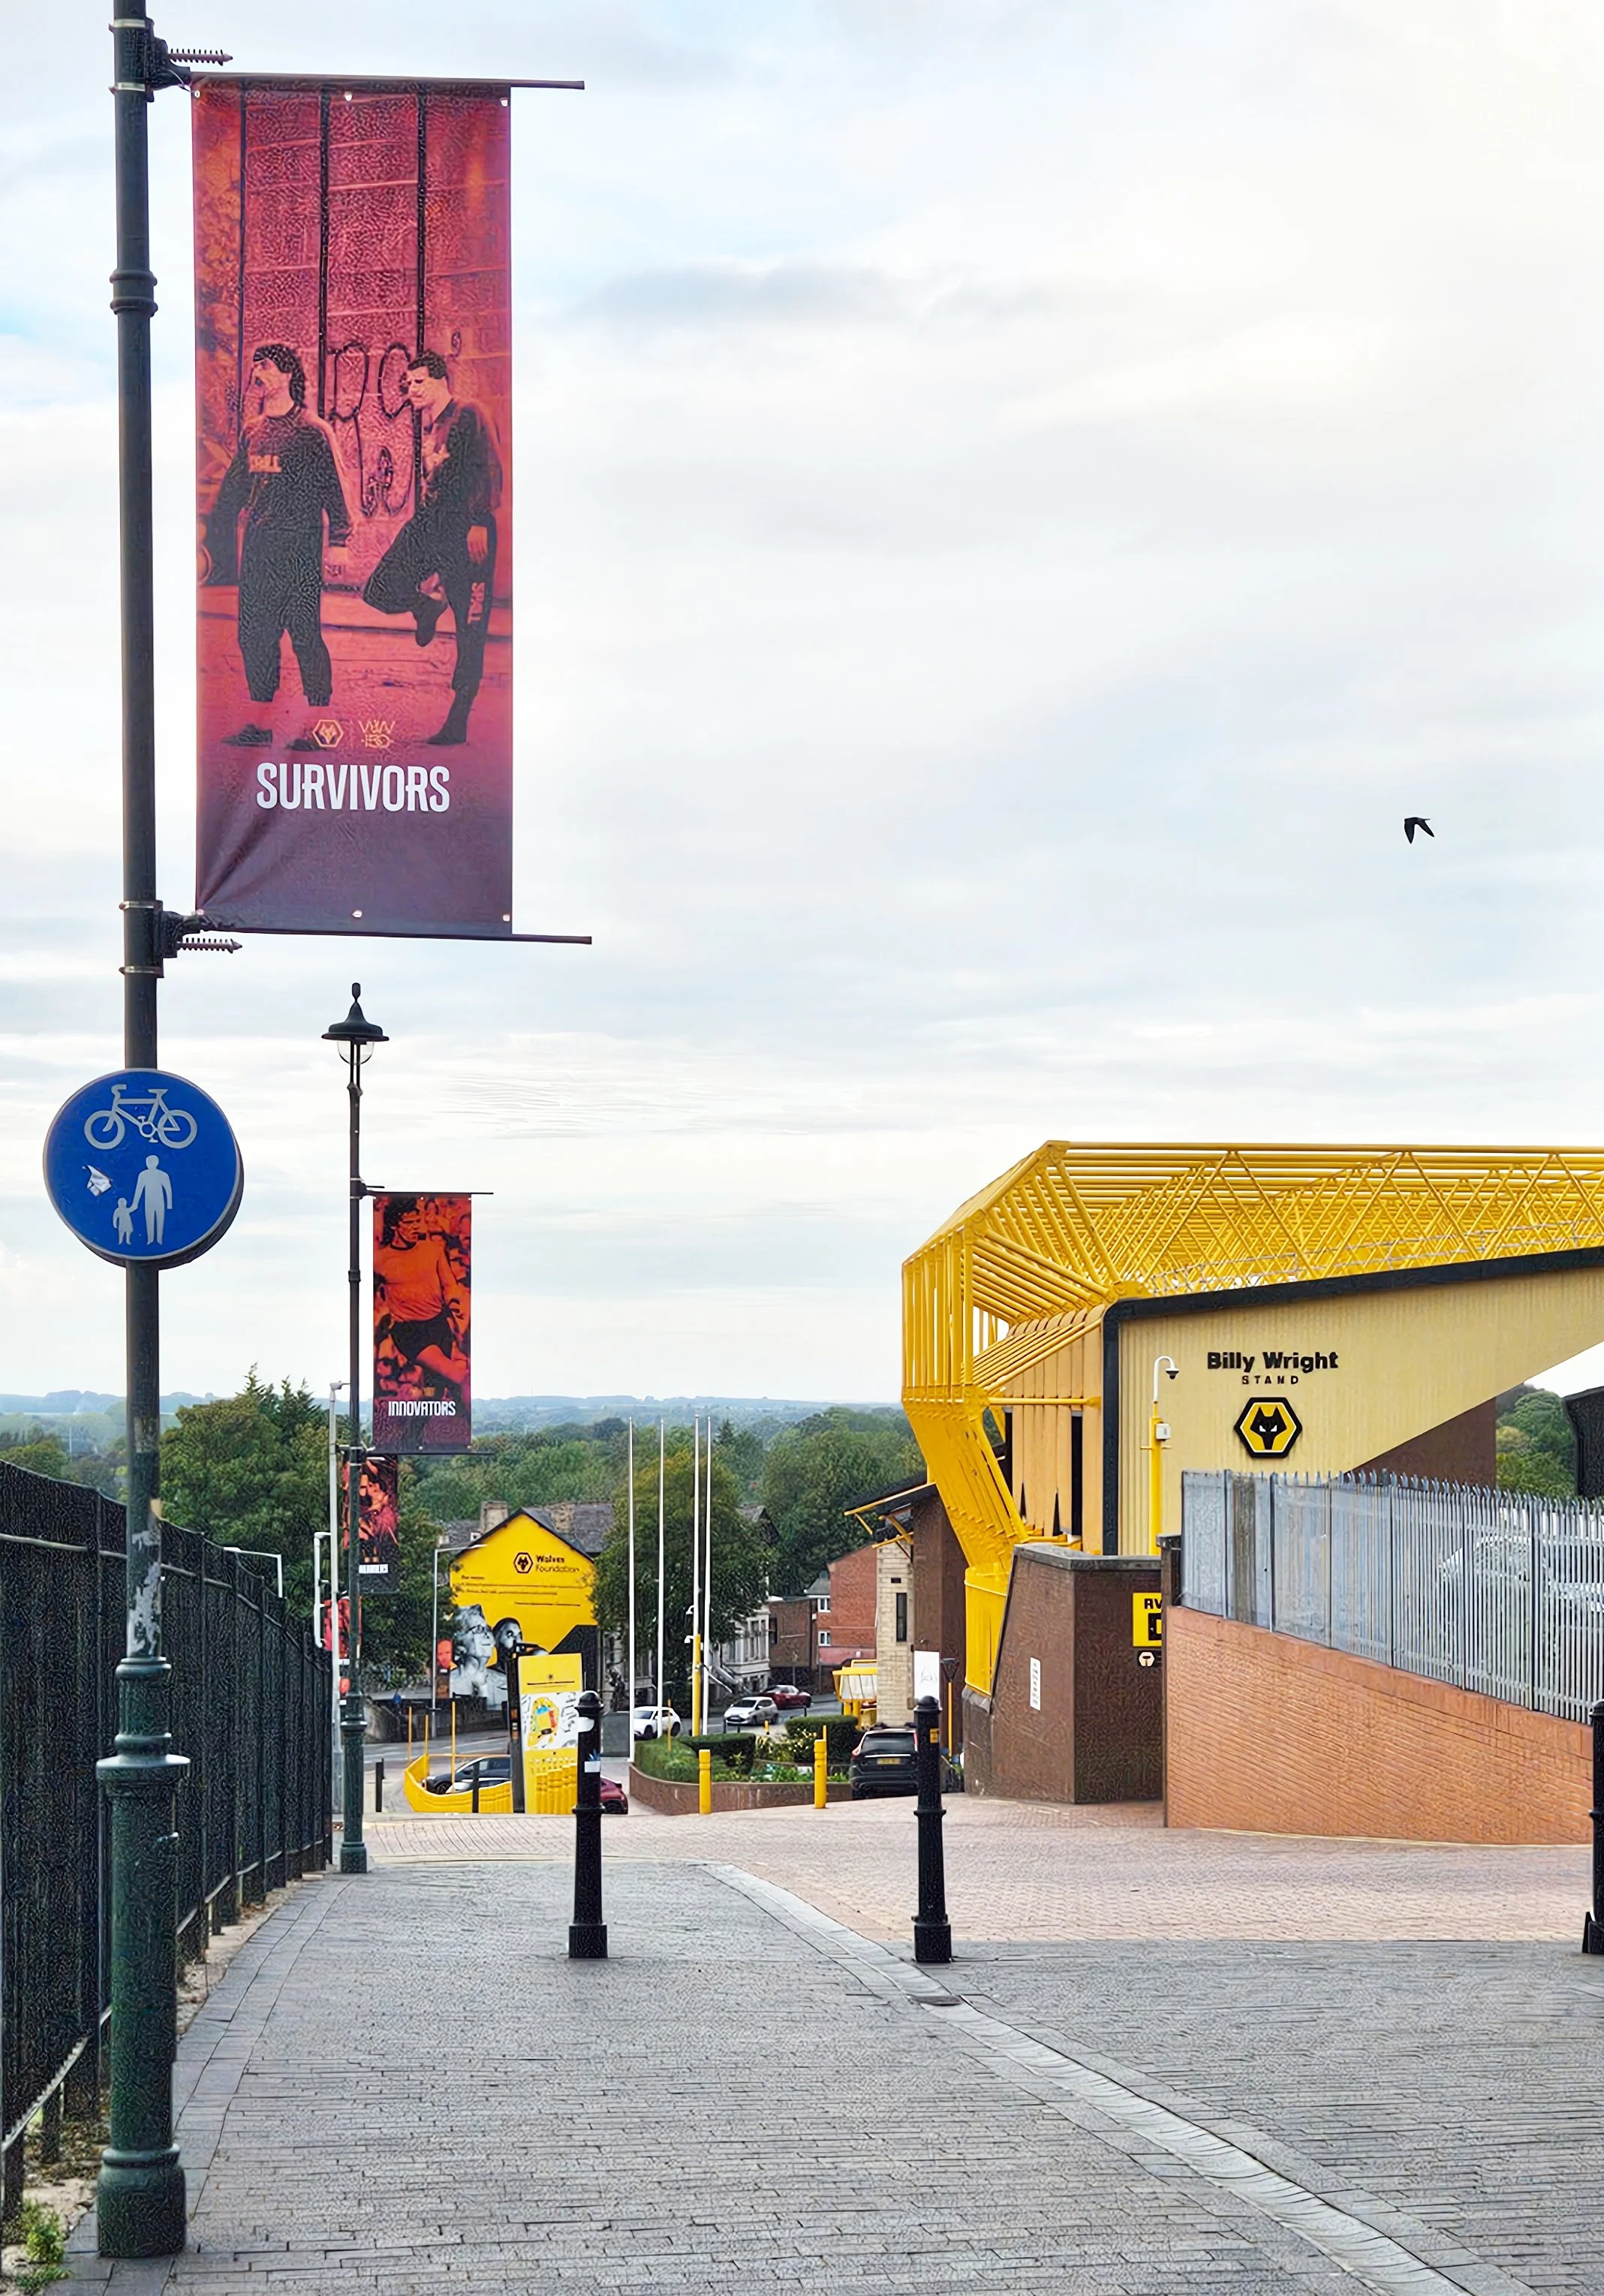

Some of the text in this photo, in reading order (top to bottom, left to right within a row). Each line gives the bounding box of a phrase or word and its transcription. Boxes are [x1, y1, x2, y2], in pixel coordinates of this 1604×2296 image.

[256, 762, 450, 813] SURVIVORS
[1207, 1351, 1339, 1374] Billy Wright
[1241, 1375, 1299, 1385] STAND
[388, 1401, 456, 1416] INNOVATORS
[536, 1555, 565, 1563] Wolves
[535, 1564, 580, 1573] Foundation
